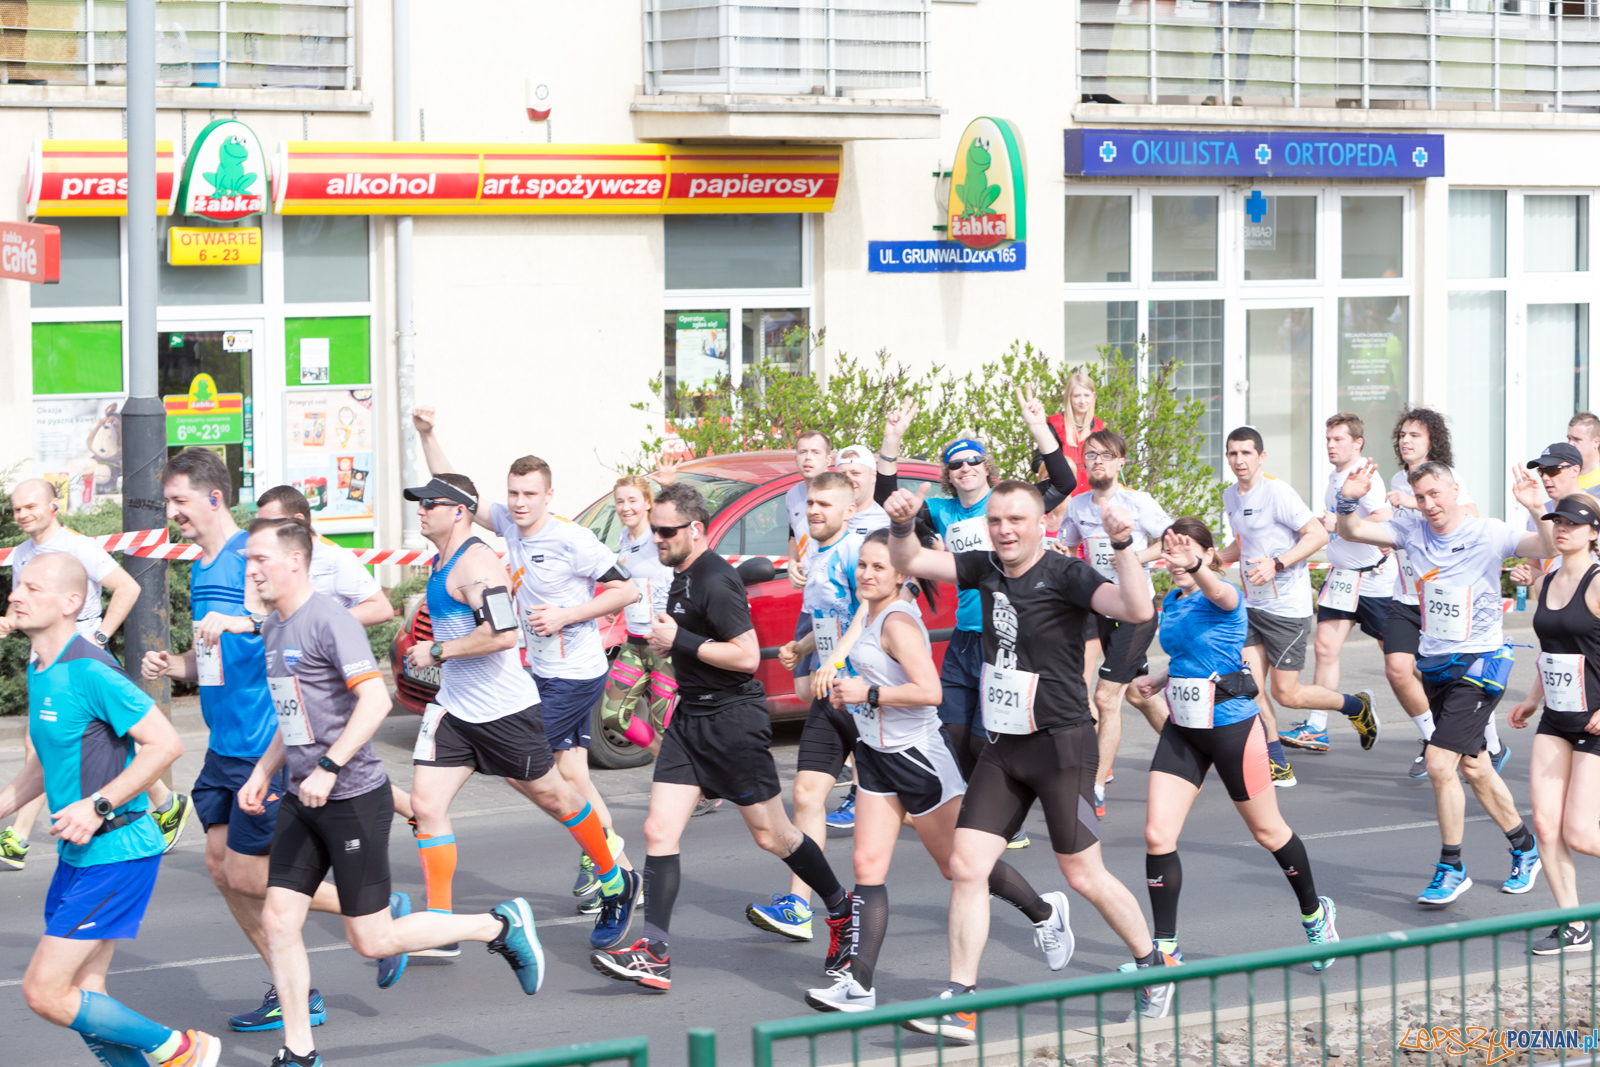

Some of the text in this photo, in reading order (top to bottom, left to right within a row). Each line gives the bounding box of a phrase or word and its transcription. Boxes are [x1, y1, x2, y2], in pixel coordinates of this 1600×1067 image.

[1132, 140, 1398, 167] OKULISTA ORTOPEDA
[62, 175, 128, 199] pras
[326, 173, 436, 195] alkohol
[483, 174, 662, 199] art.spożywcze
[688, 174, 824, 198] papierosy
[194, 194, 262, 213] żabka
[951, 215, 1007, 236] żabka
[181, 231, 258, 247] OTWARTE
[2, 239, 37, 275] café
[199, 249, 208, 261] 6
[223, 249, 240, 261] 23
[880, 248, 1017, 264] UL. GRUNWALDZKA 165
[36, 406, 62, 416] Okazja
[951, 533, 982, 552] 1044
[1330, 580, 1352, 594] 4798
[1429, 600, 1460, 618] 2935
[342, 659, 372, 673] Roca
[1543, 671, 1573, 687] 3579
[988, 686, 1019, 708] 8921
[1172, 685, 1200, 702] 9168
